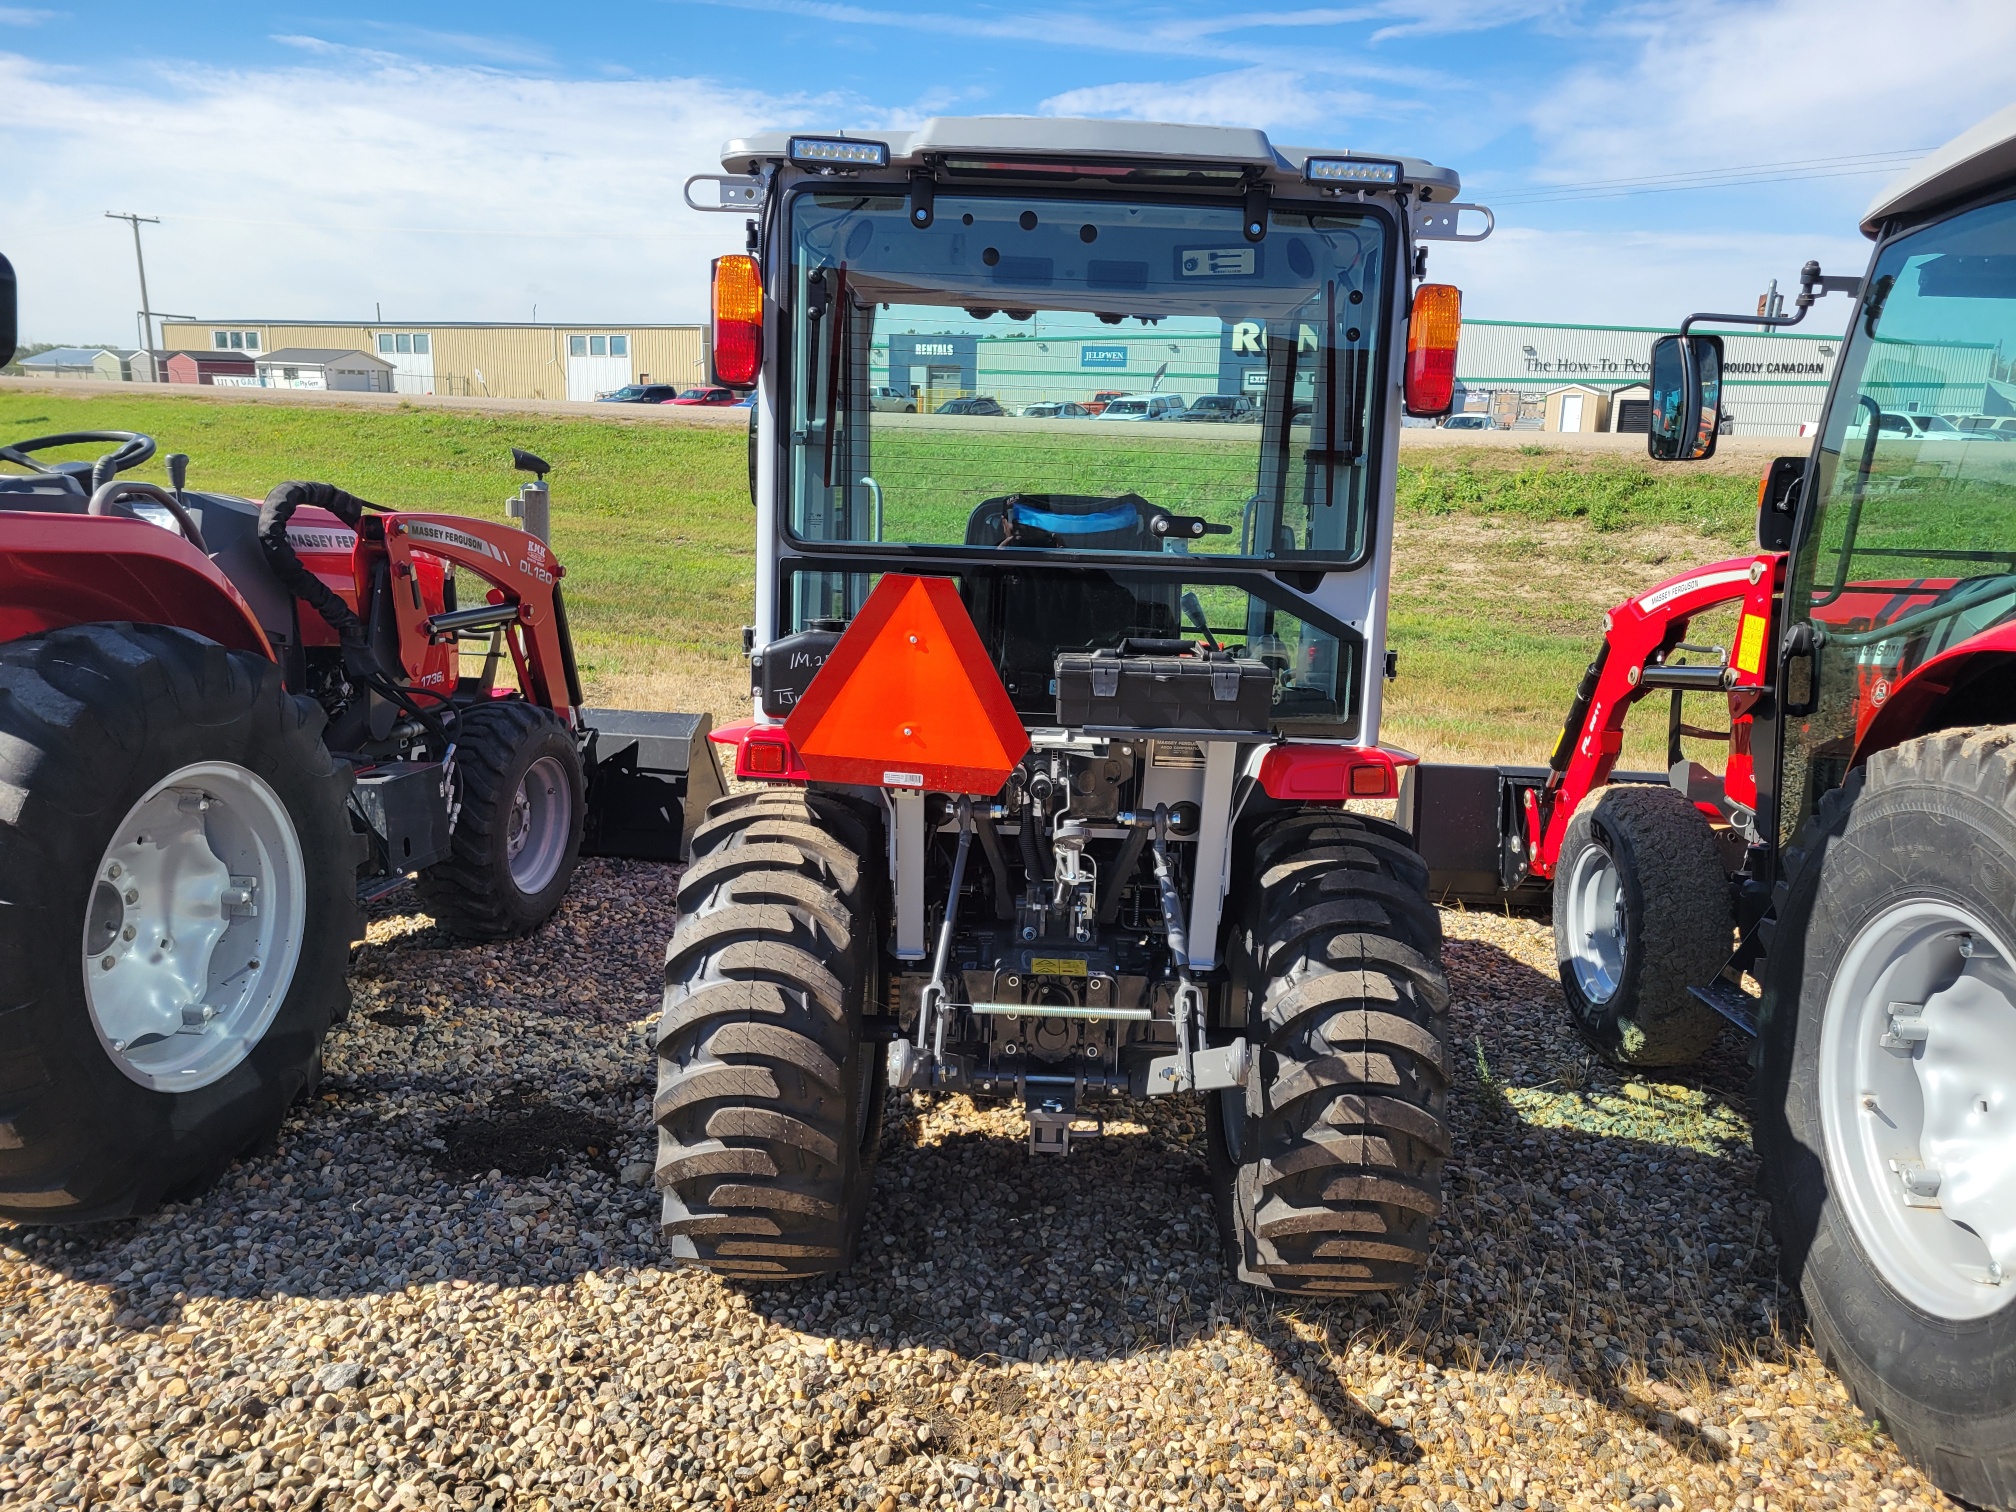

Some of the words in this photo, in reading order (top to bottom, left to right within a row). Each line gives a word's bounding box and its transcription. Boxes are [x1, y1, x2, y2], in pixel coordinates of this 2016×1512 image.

[915, 343, 954, 356] RENTALS
[1524, 358, 1551, 373] The
[1557, 358, 1618, 373] How-To
[1766, 363, 1824, 374] CANADIAN
[288, 533, 334, 548] MASSEY
[411, 525, 444, 539] MASSEY
[445, 531, 483, 551] FERGUSON
[1651, 590, 1671, 605] MASSEY
[1671, 579, 1699, 596] FERGUSON
